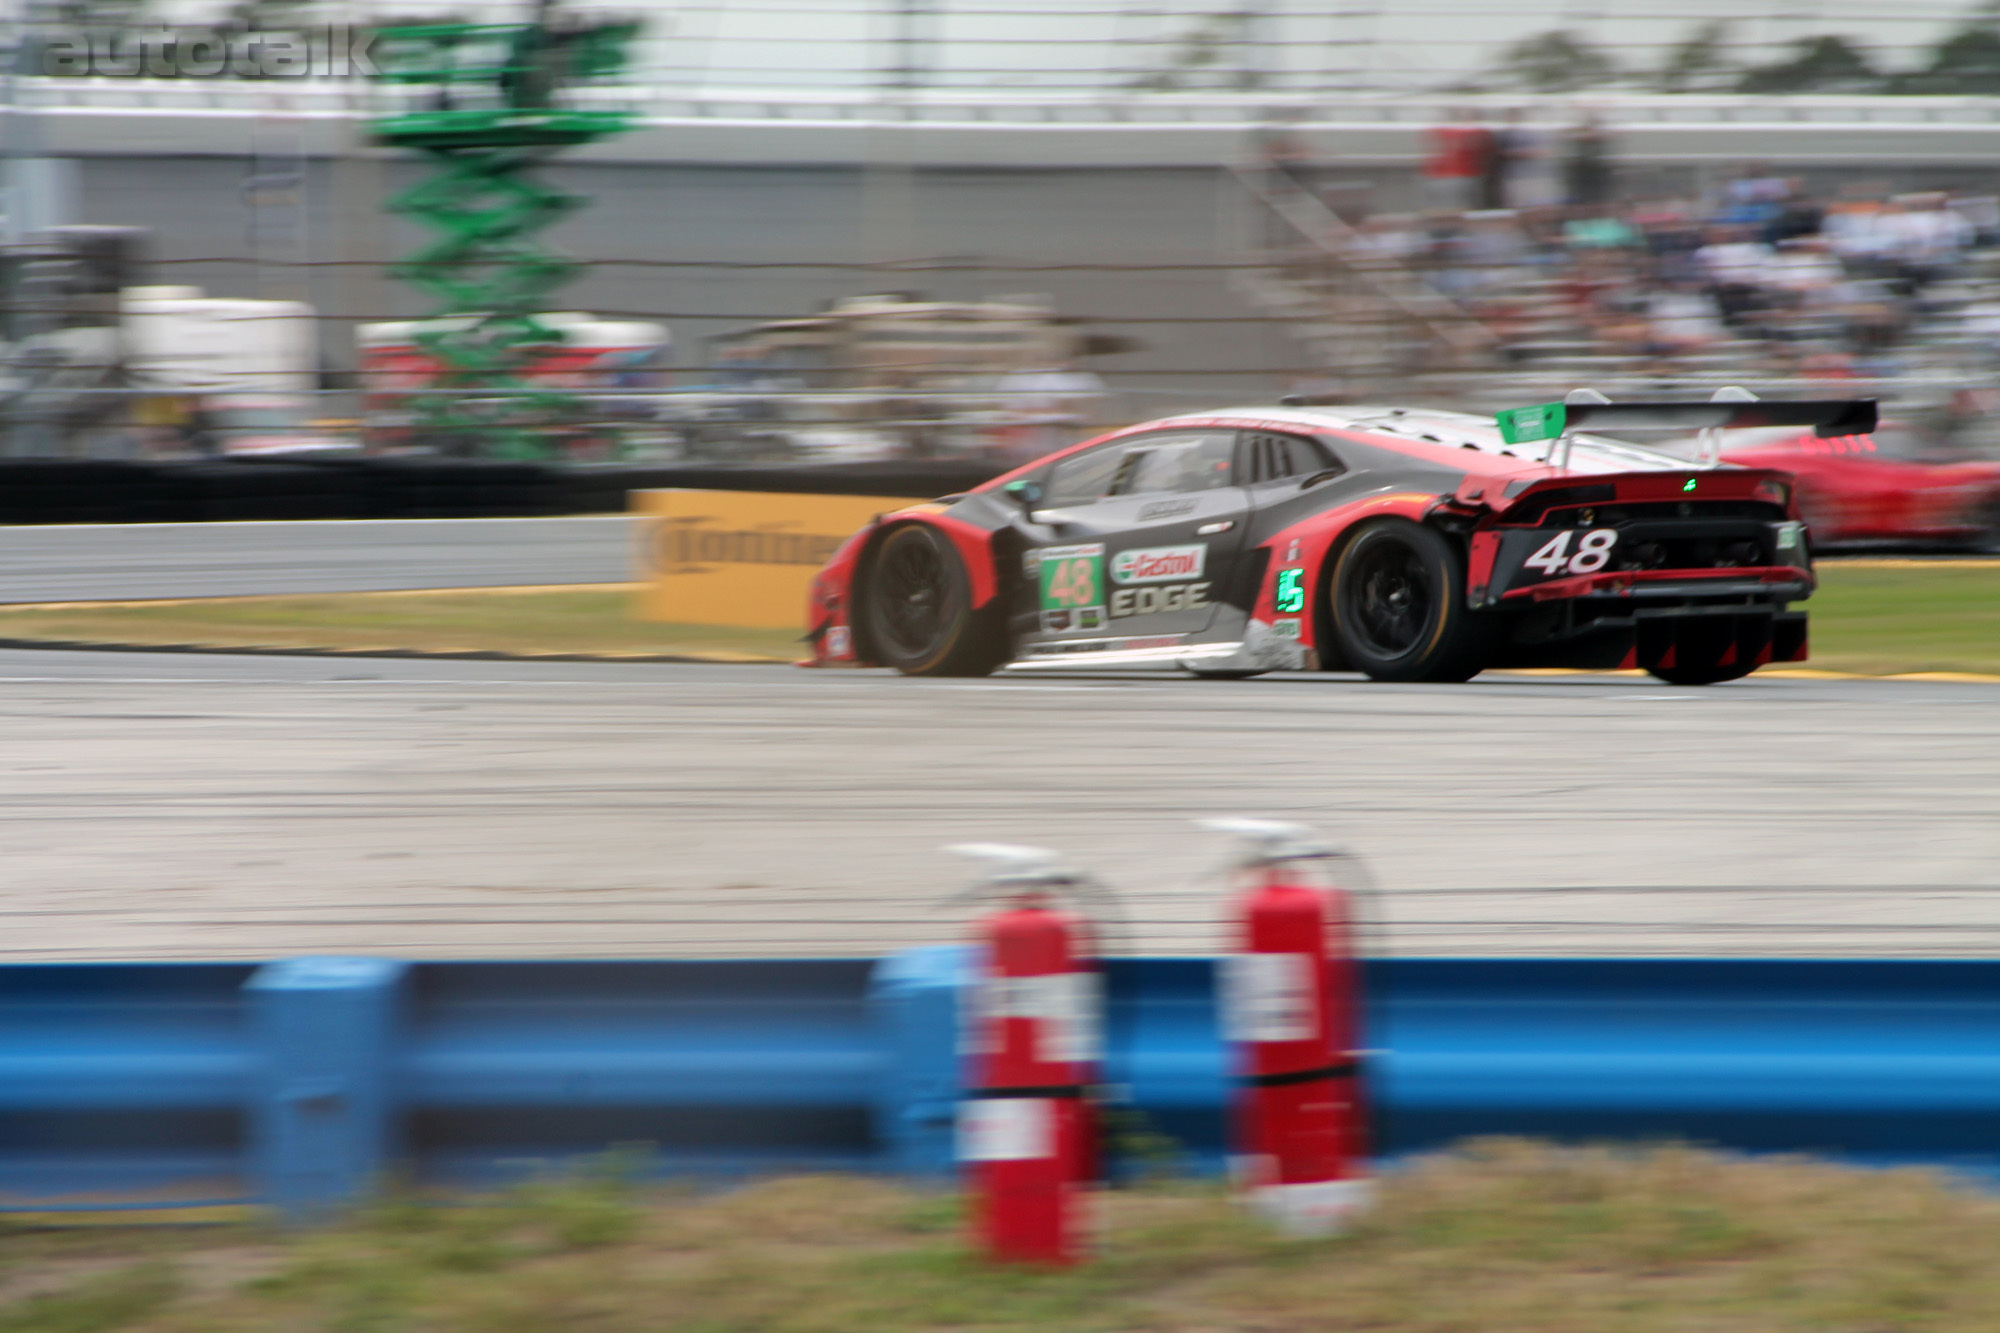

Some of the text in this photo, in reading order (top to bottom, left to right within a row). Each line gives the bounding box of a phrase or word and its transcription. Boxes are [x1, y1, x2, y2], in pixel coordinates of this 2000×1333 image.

[1523, 529, 1618, 575] 48
[1047, 558, 1095, 607] 48
[1111, 582, 1212, 617] EDGE
